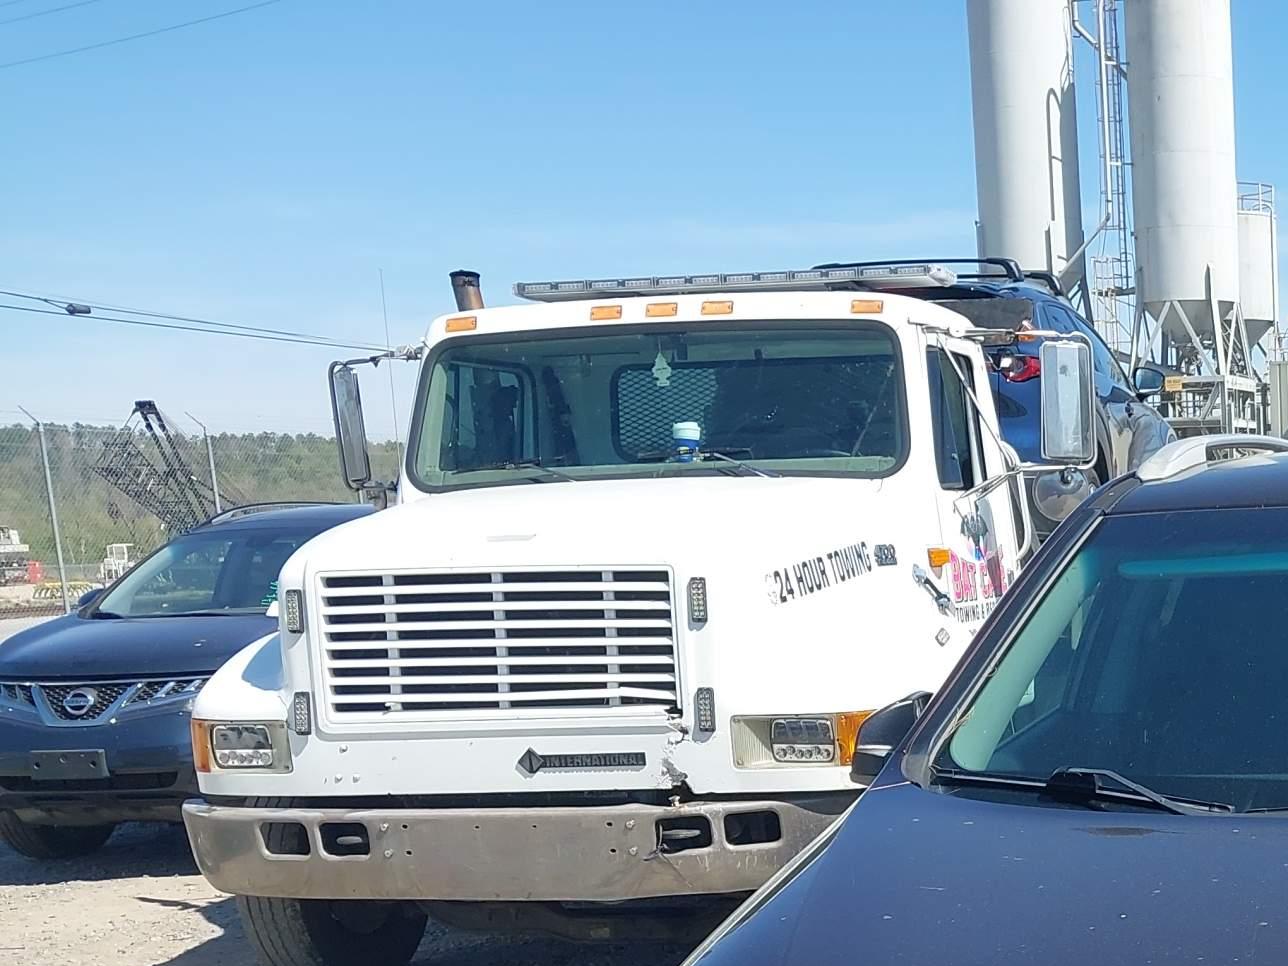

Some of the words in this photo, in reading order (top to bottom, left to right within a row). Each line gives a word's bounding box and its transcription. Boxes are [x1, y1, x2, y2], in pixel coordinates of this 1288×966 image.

[773, 565, 795, 603] 24
[793, 556, 830, 597] HOUR
[827, 541, 872, 585] TOWING
[950, 549, 977, 603] BAT
[955, 604, 980, 623] TOWING
[545, 753, 645, 767] INTERNATIONAL
